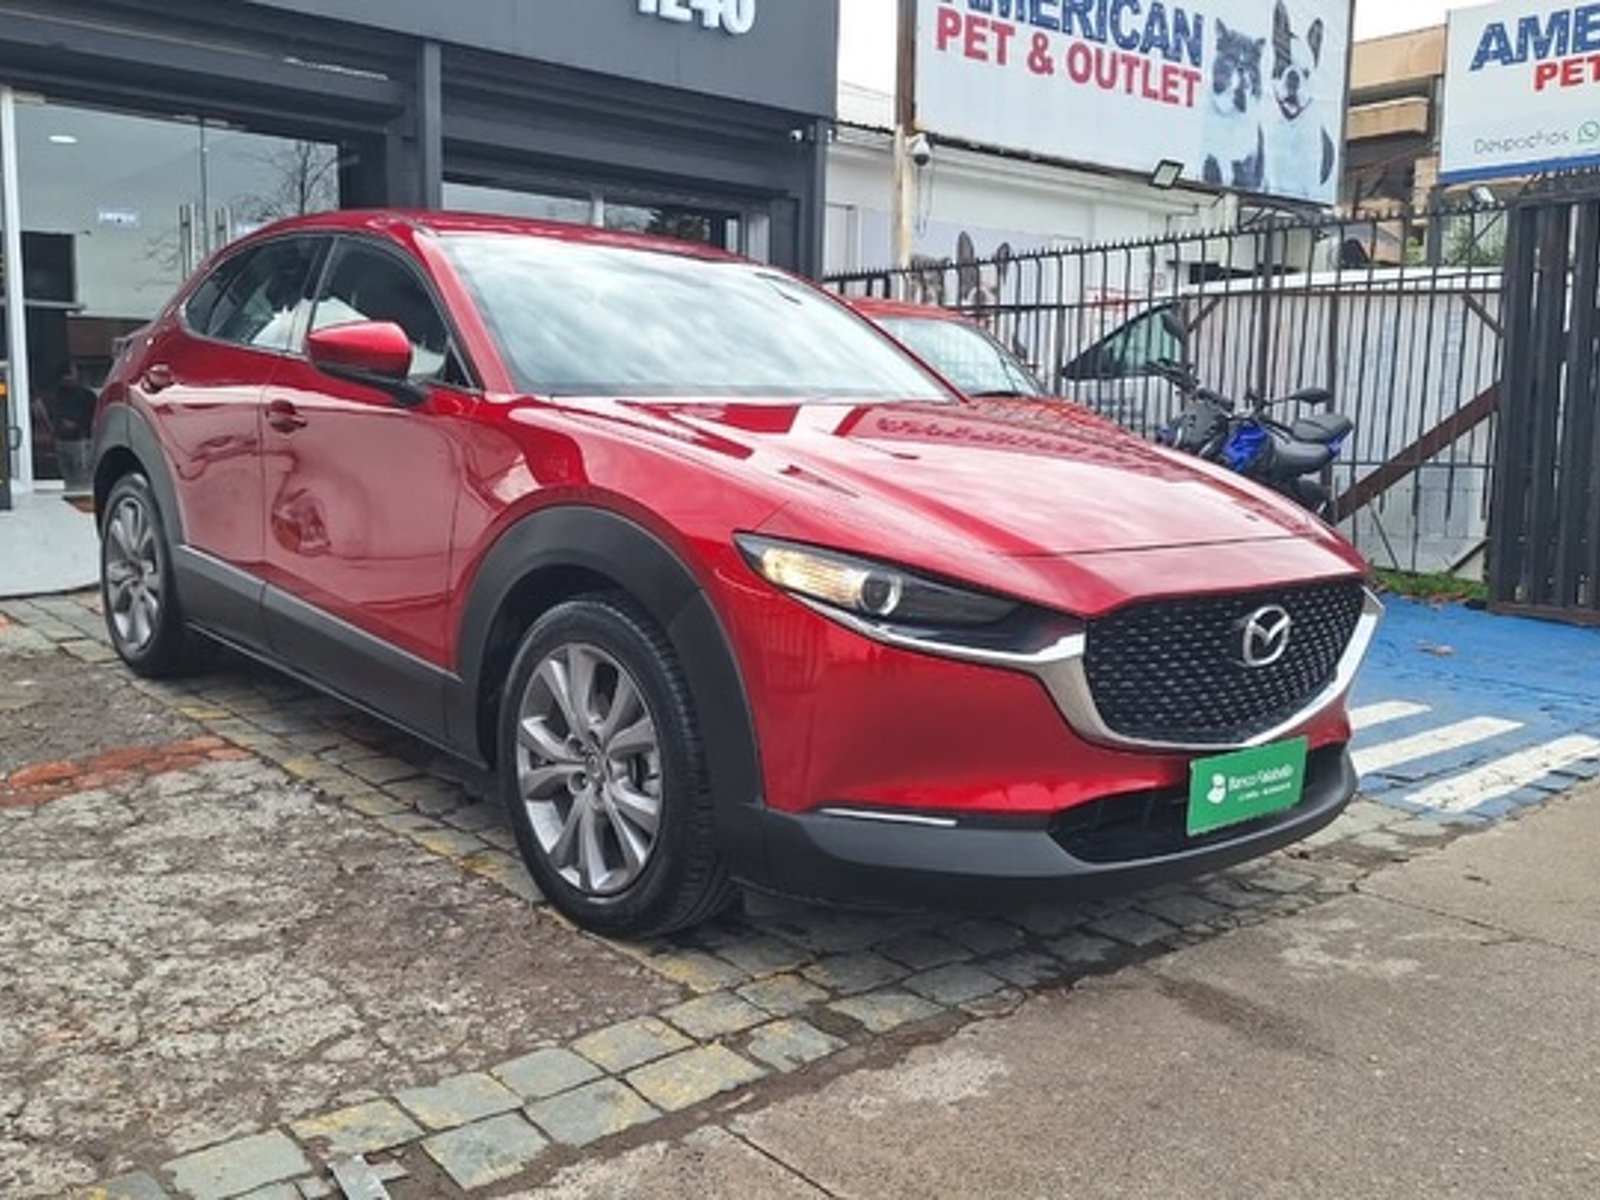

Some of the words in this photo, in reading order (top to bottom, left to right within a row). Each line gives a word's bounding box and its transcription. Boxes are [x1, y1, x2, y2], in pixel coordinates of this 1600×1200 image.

[637, 0, 756, 35] 40
[943, 0, 1203, 69] ERICAN
[936, 6, 1016, 66] PET
[1027, 31, 1054, 76] &
[1067, 41, 1202, 108] OUTLET
